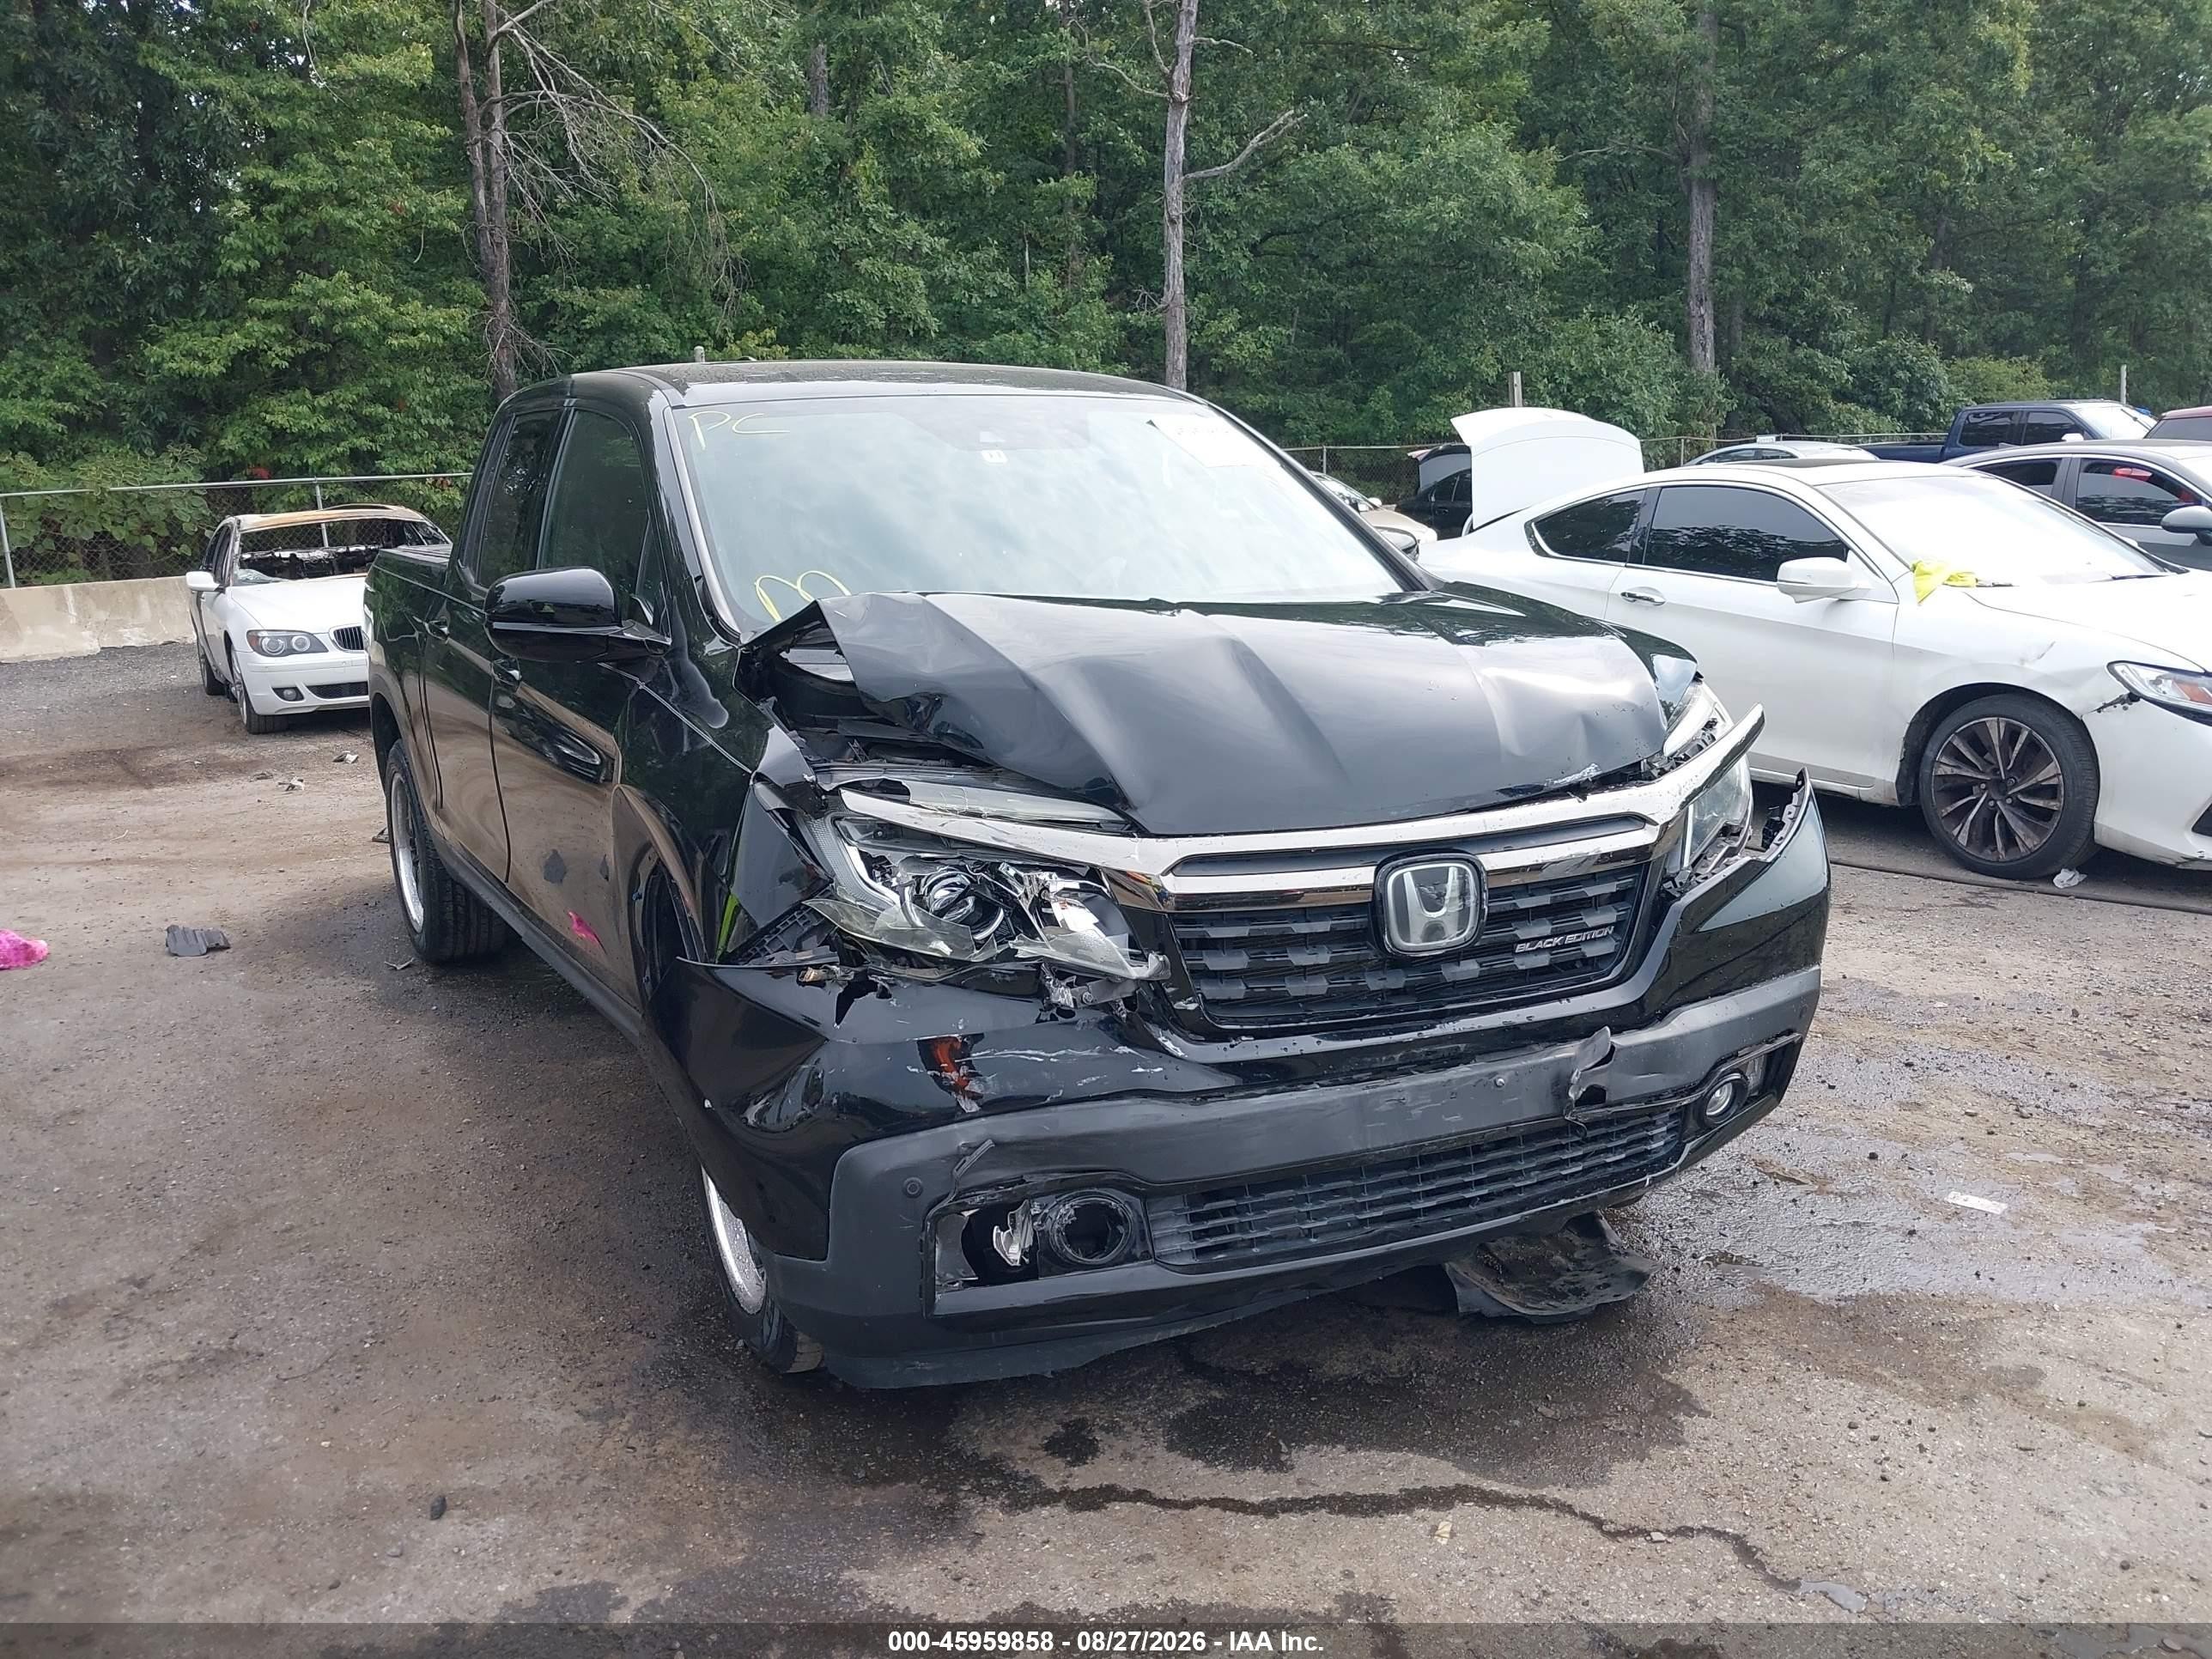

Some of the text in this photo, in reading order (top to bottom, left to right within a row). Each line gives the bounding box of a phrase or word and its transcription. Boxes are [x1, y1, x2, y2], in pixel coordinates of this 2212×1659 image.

[688, 410, 790, 450] PC
[1515, 926, 1615, 953] BLACK EDITION
